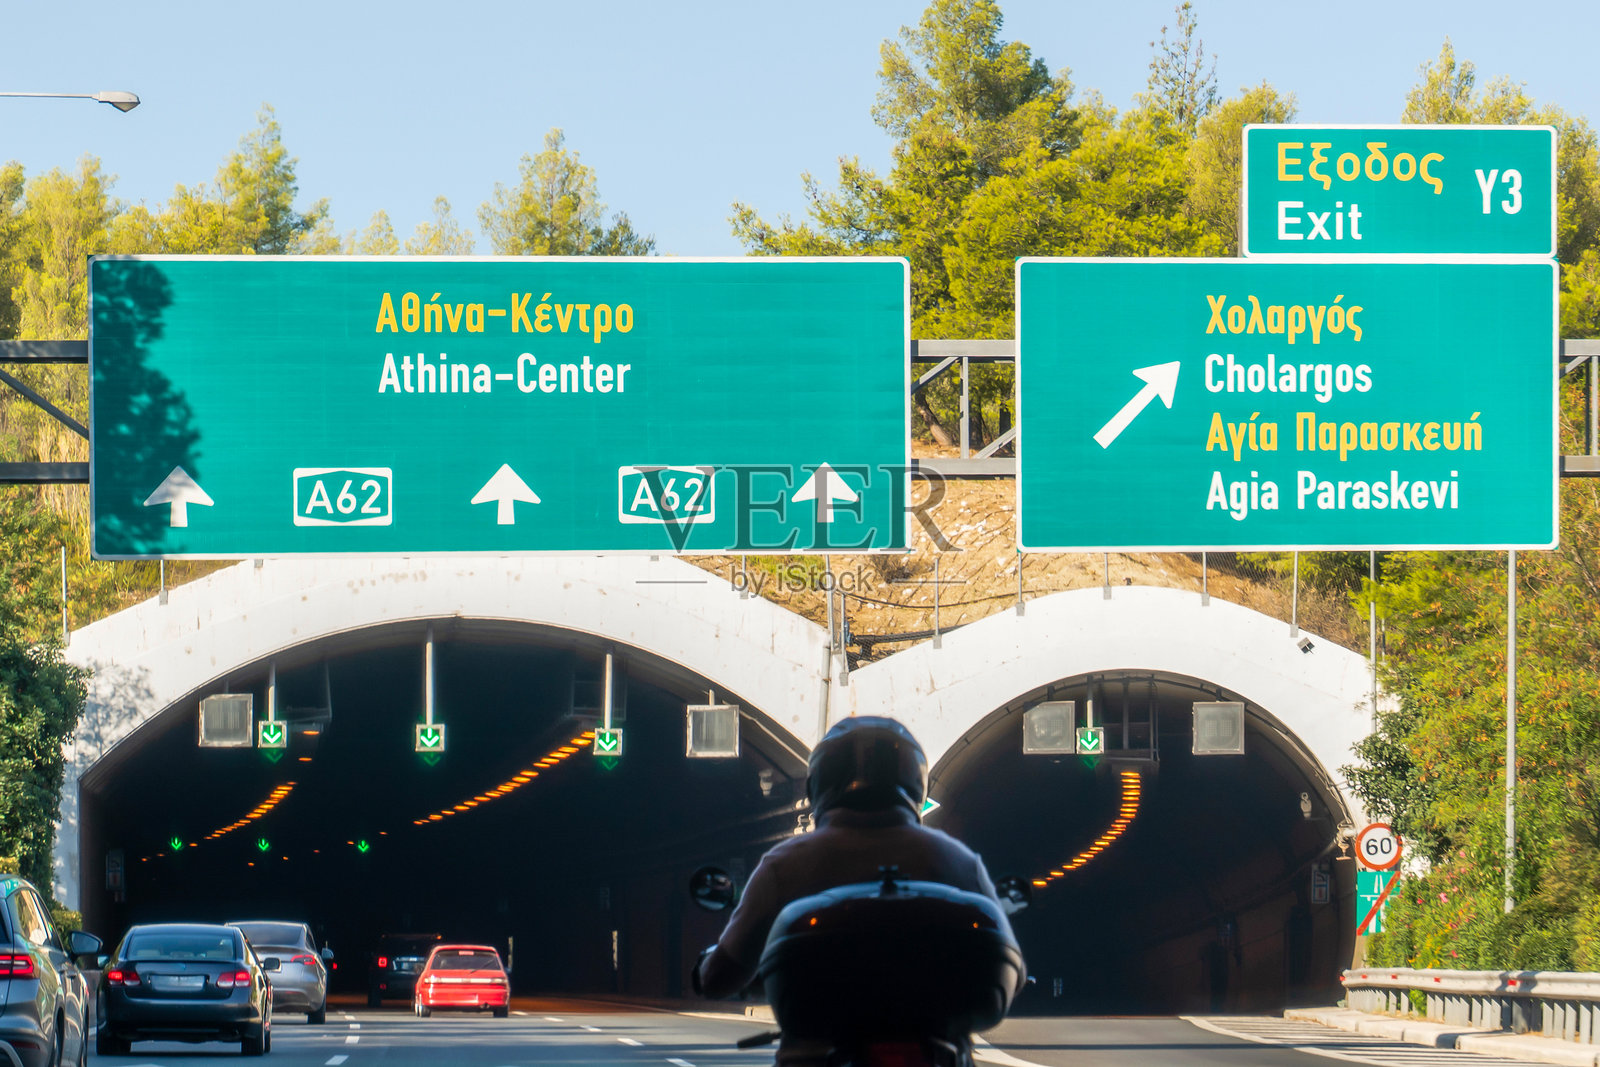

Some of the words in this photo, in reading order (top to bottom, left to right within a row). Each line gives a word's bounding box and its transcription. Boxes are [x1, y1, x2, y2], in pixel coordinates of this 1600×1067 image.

[1277, 141, 1445, 195] Εξοδος
[1474, 168, 1523, 215] Y3
[1277, 200, 1363, 241] Exit
[375, 292, 634, 344] Αθήνα-Κέντρο
[1205, 294, 1364, 345] Χολαργός
[378, 352, 631, 394] Athina-Center
[1204, 353, 1373, 404] Cholargos
[1205, 411, 1278, 462] Αγία
[1296, 411, 1483, 462] Παρασκευή
[305, 479, 381, 514] A62
[630, 477, 704, 512] A62
[1206, 470, 1279, 522] Agia
[1297, 470, 1459, 510] Paraskevi
[1366, 837, 1392, 856] 60
